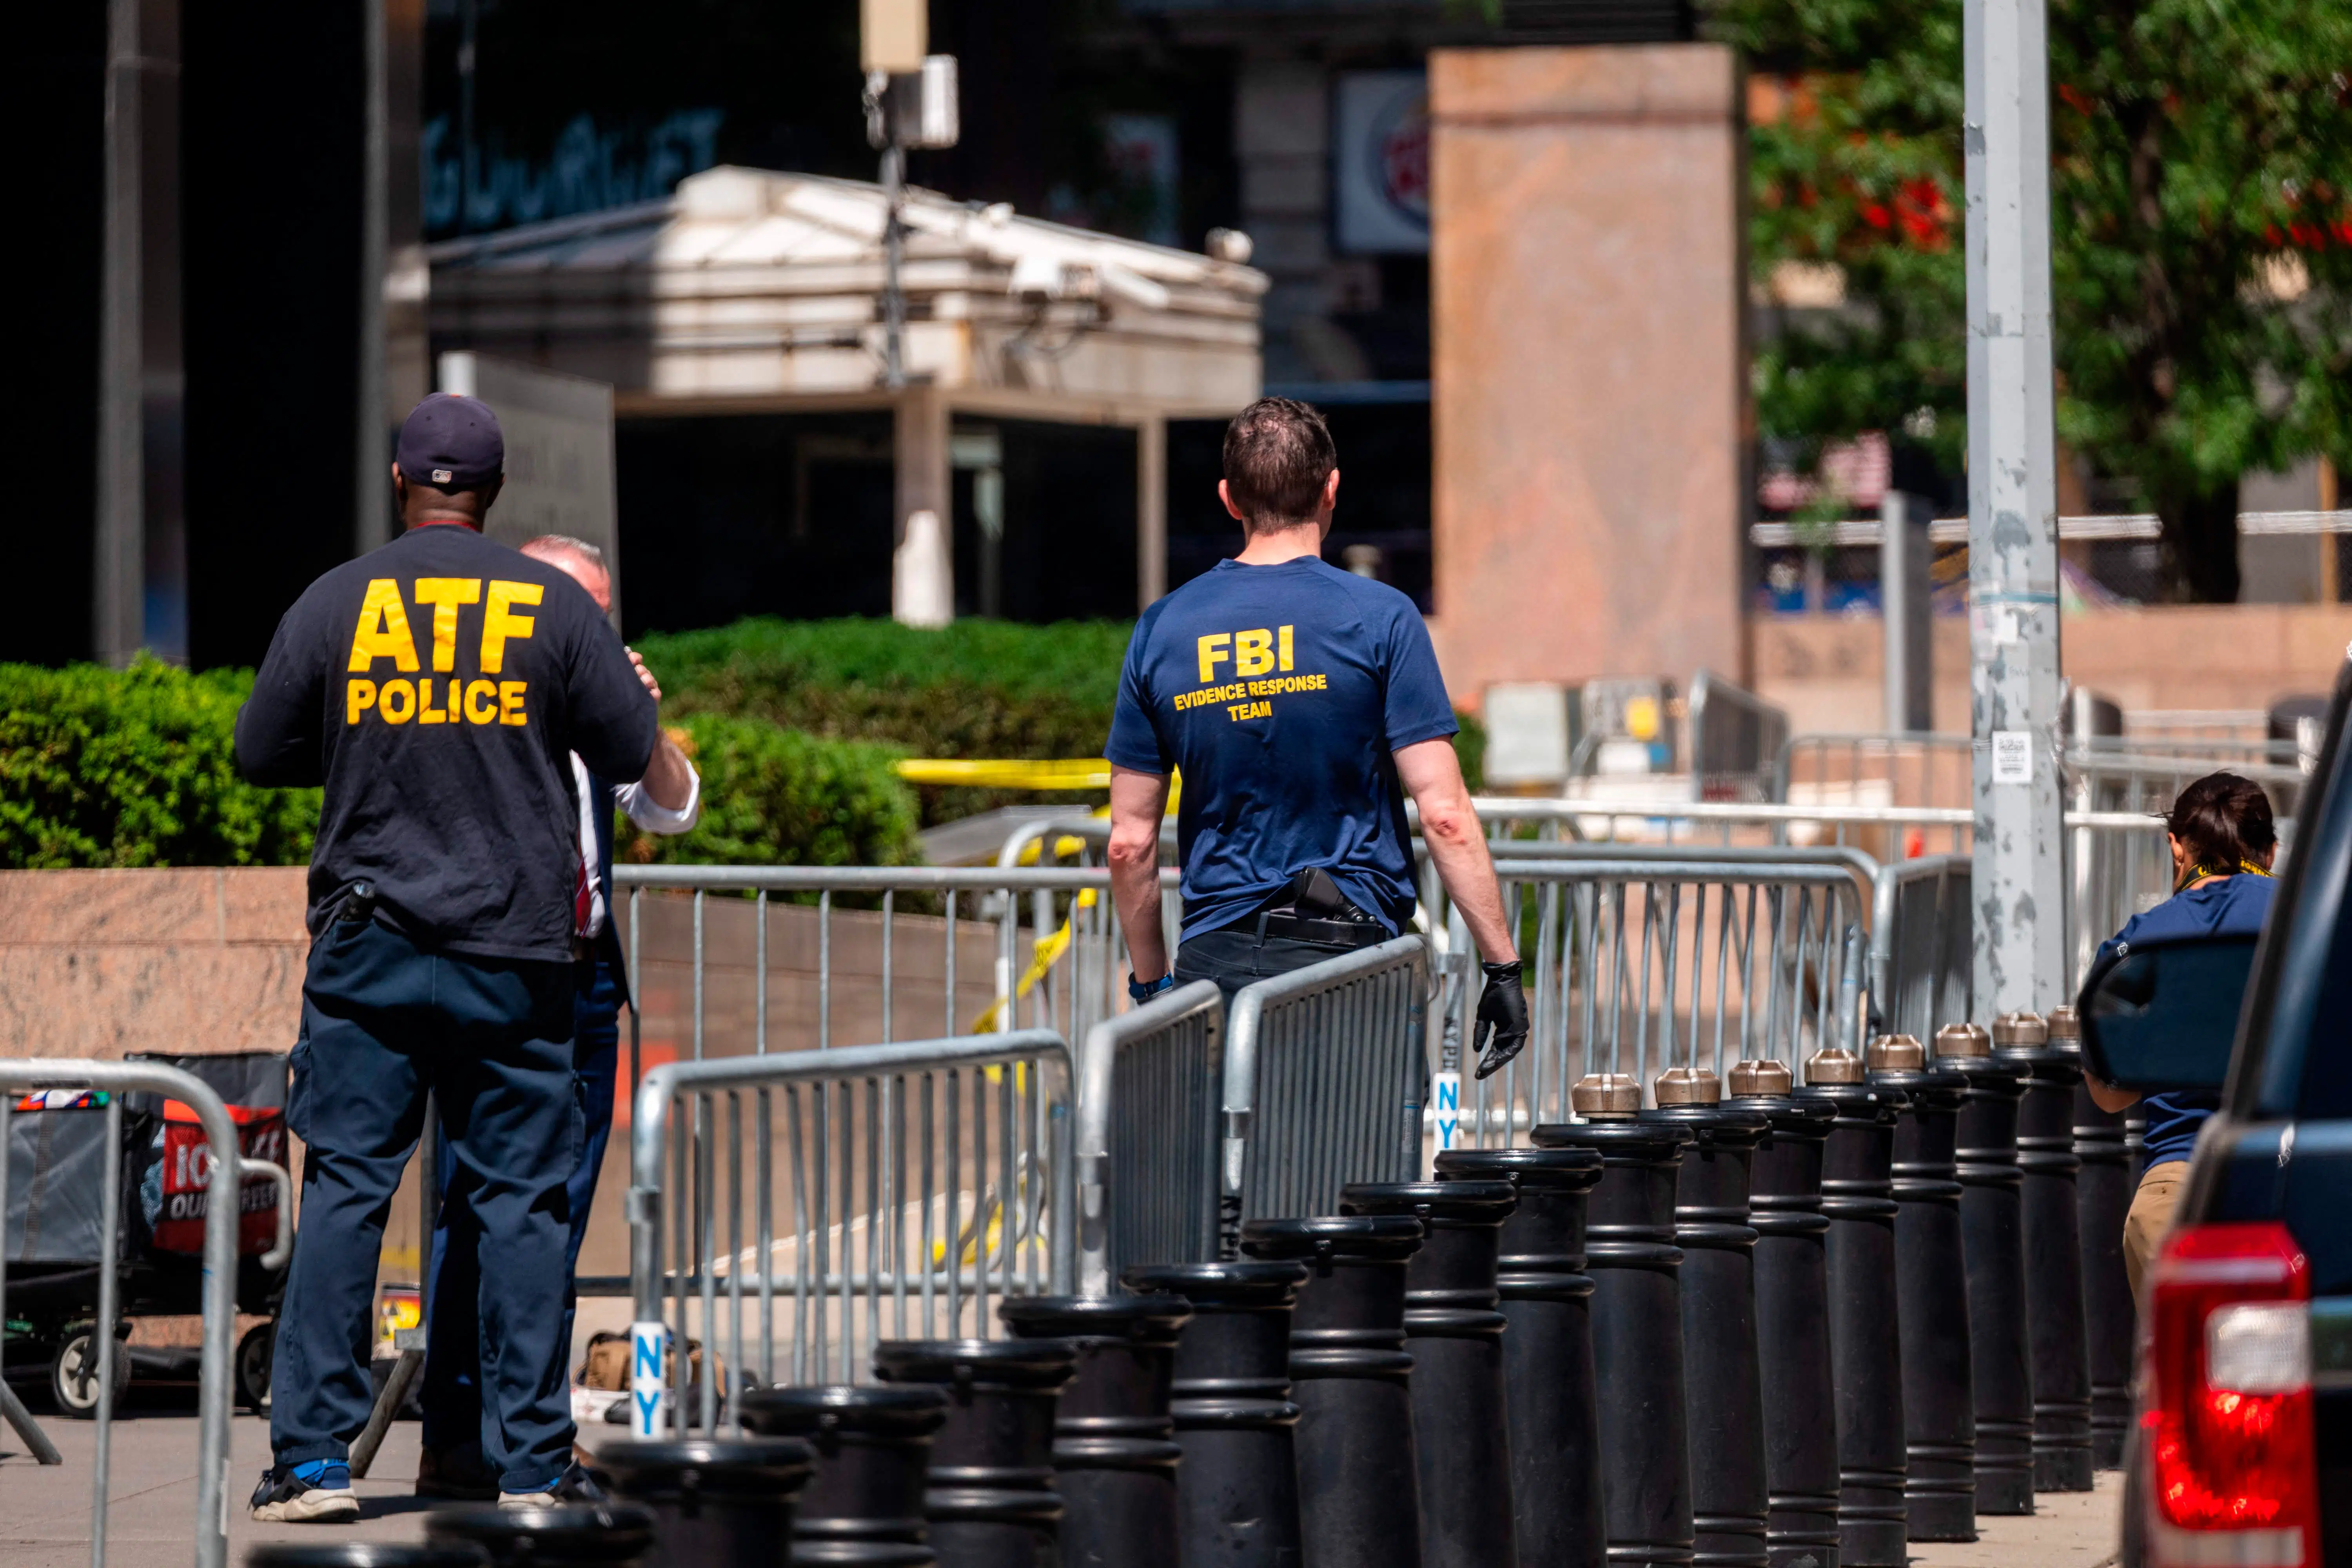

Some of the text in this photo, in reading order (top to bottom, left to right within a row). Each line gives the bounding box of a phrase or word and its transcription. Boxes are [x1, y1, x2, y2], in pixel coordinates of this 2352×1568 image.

[347, 578, 544, 673] ATF
[1198, 624, 1293, 682] FBI
[347, 679, 527, 726] POLICE
[1174, 674, 1327, 710] EVIDENCE RESPONSE
[1227, 701, 1272, 722] TEAM
[1439, 1082, 1457, 1148] NY
[637, 1336, 661, 1435] NY
